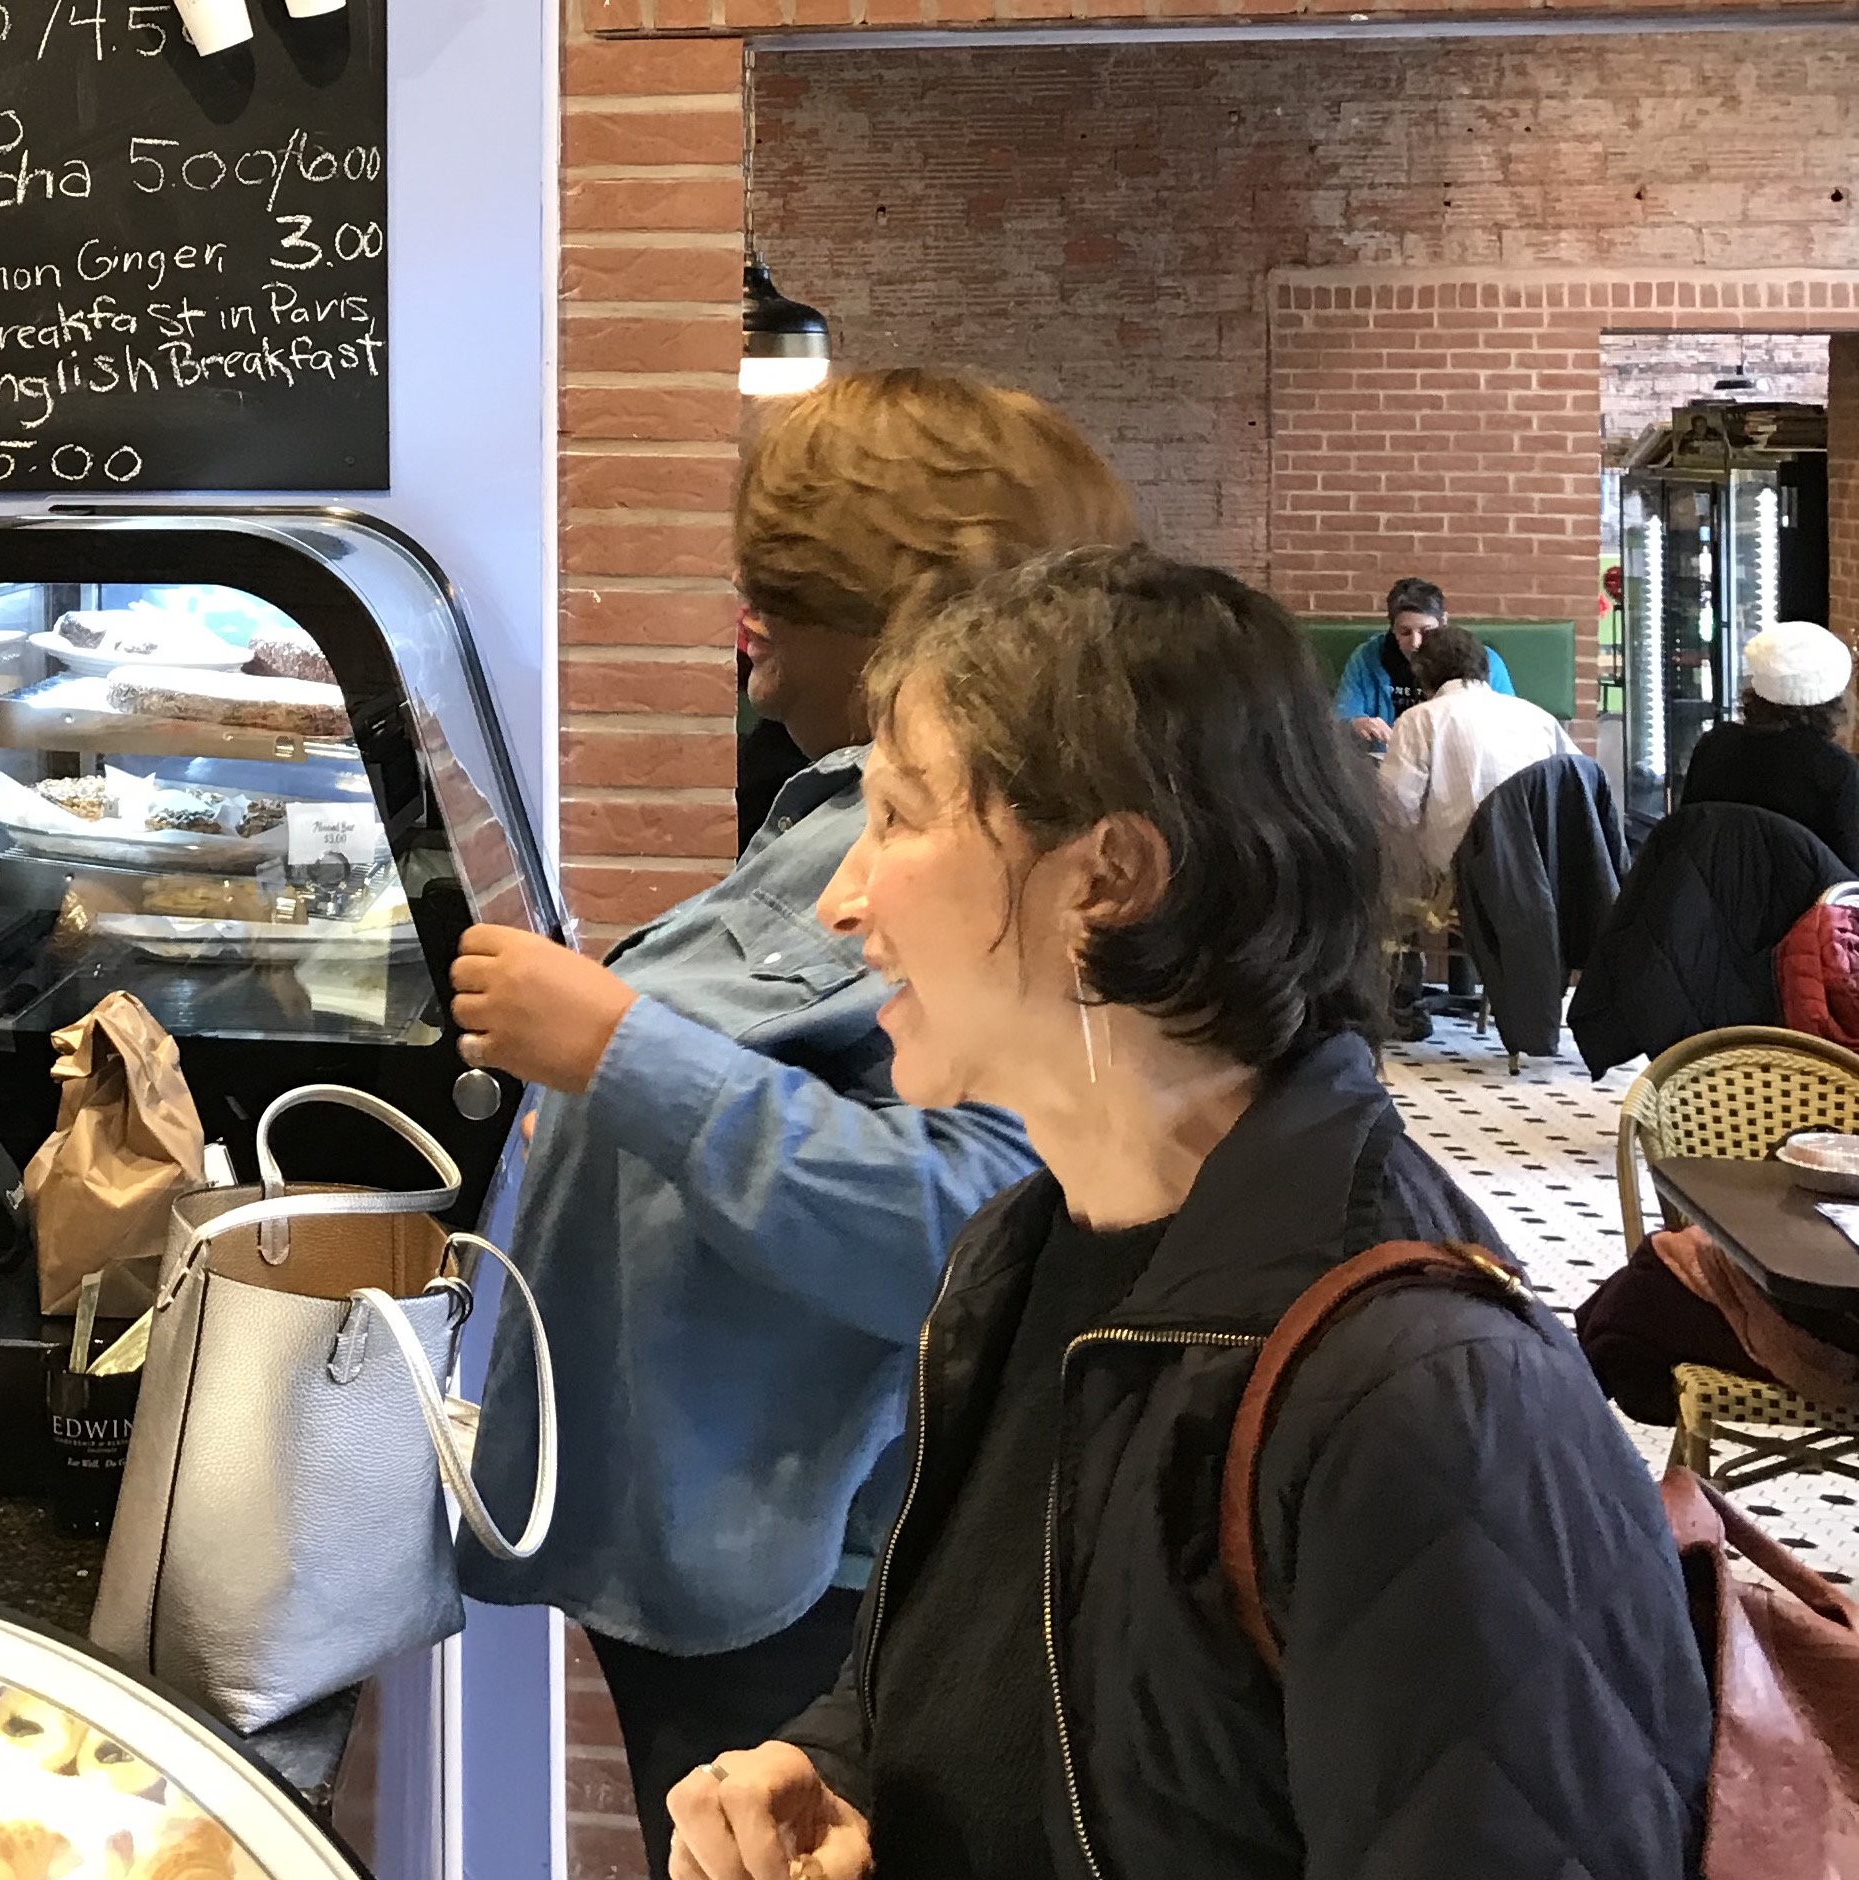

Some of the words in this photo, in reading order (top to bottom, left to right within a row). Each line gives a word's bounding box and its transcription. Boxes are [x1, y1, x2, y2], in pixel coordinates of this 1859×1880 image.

[37, 0, 196, 61] /4.5
[215, 296, 257, 335] in
[157, 335, 385, 389] Breakfast
[52, 1415, 133, 1439] EDWIN
